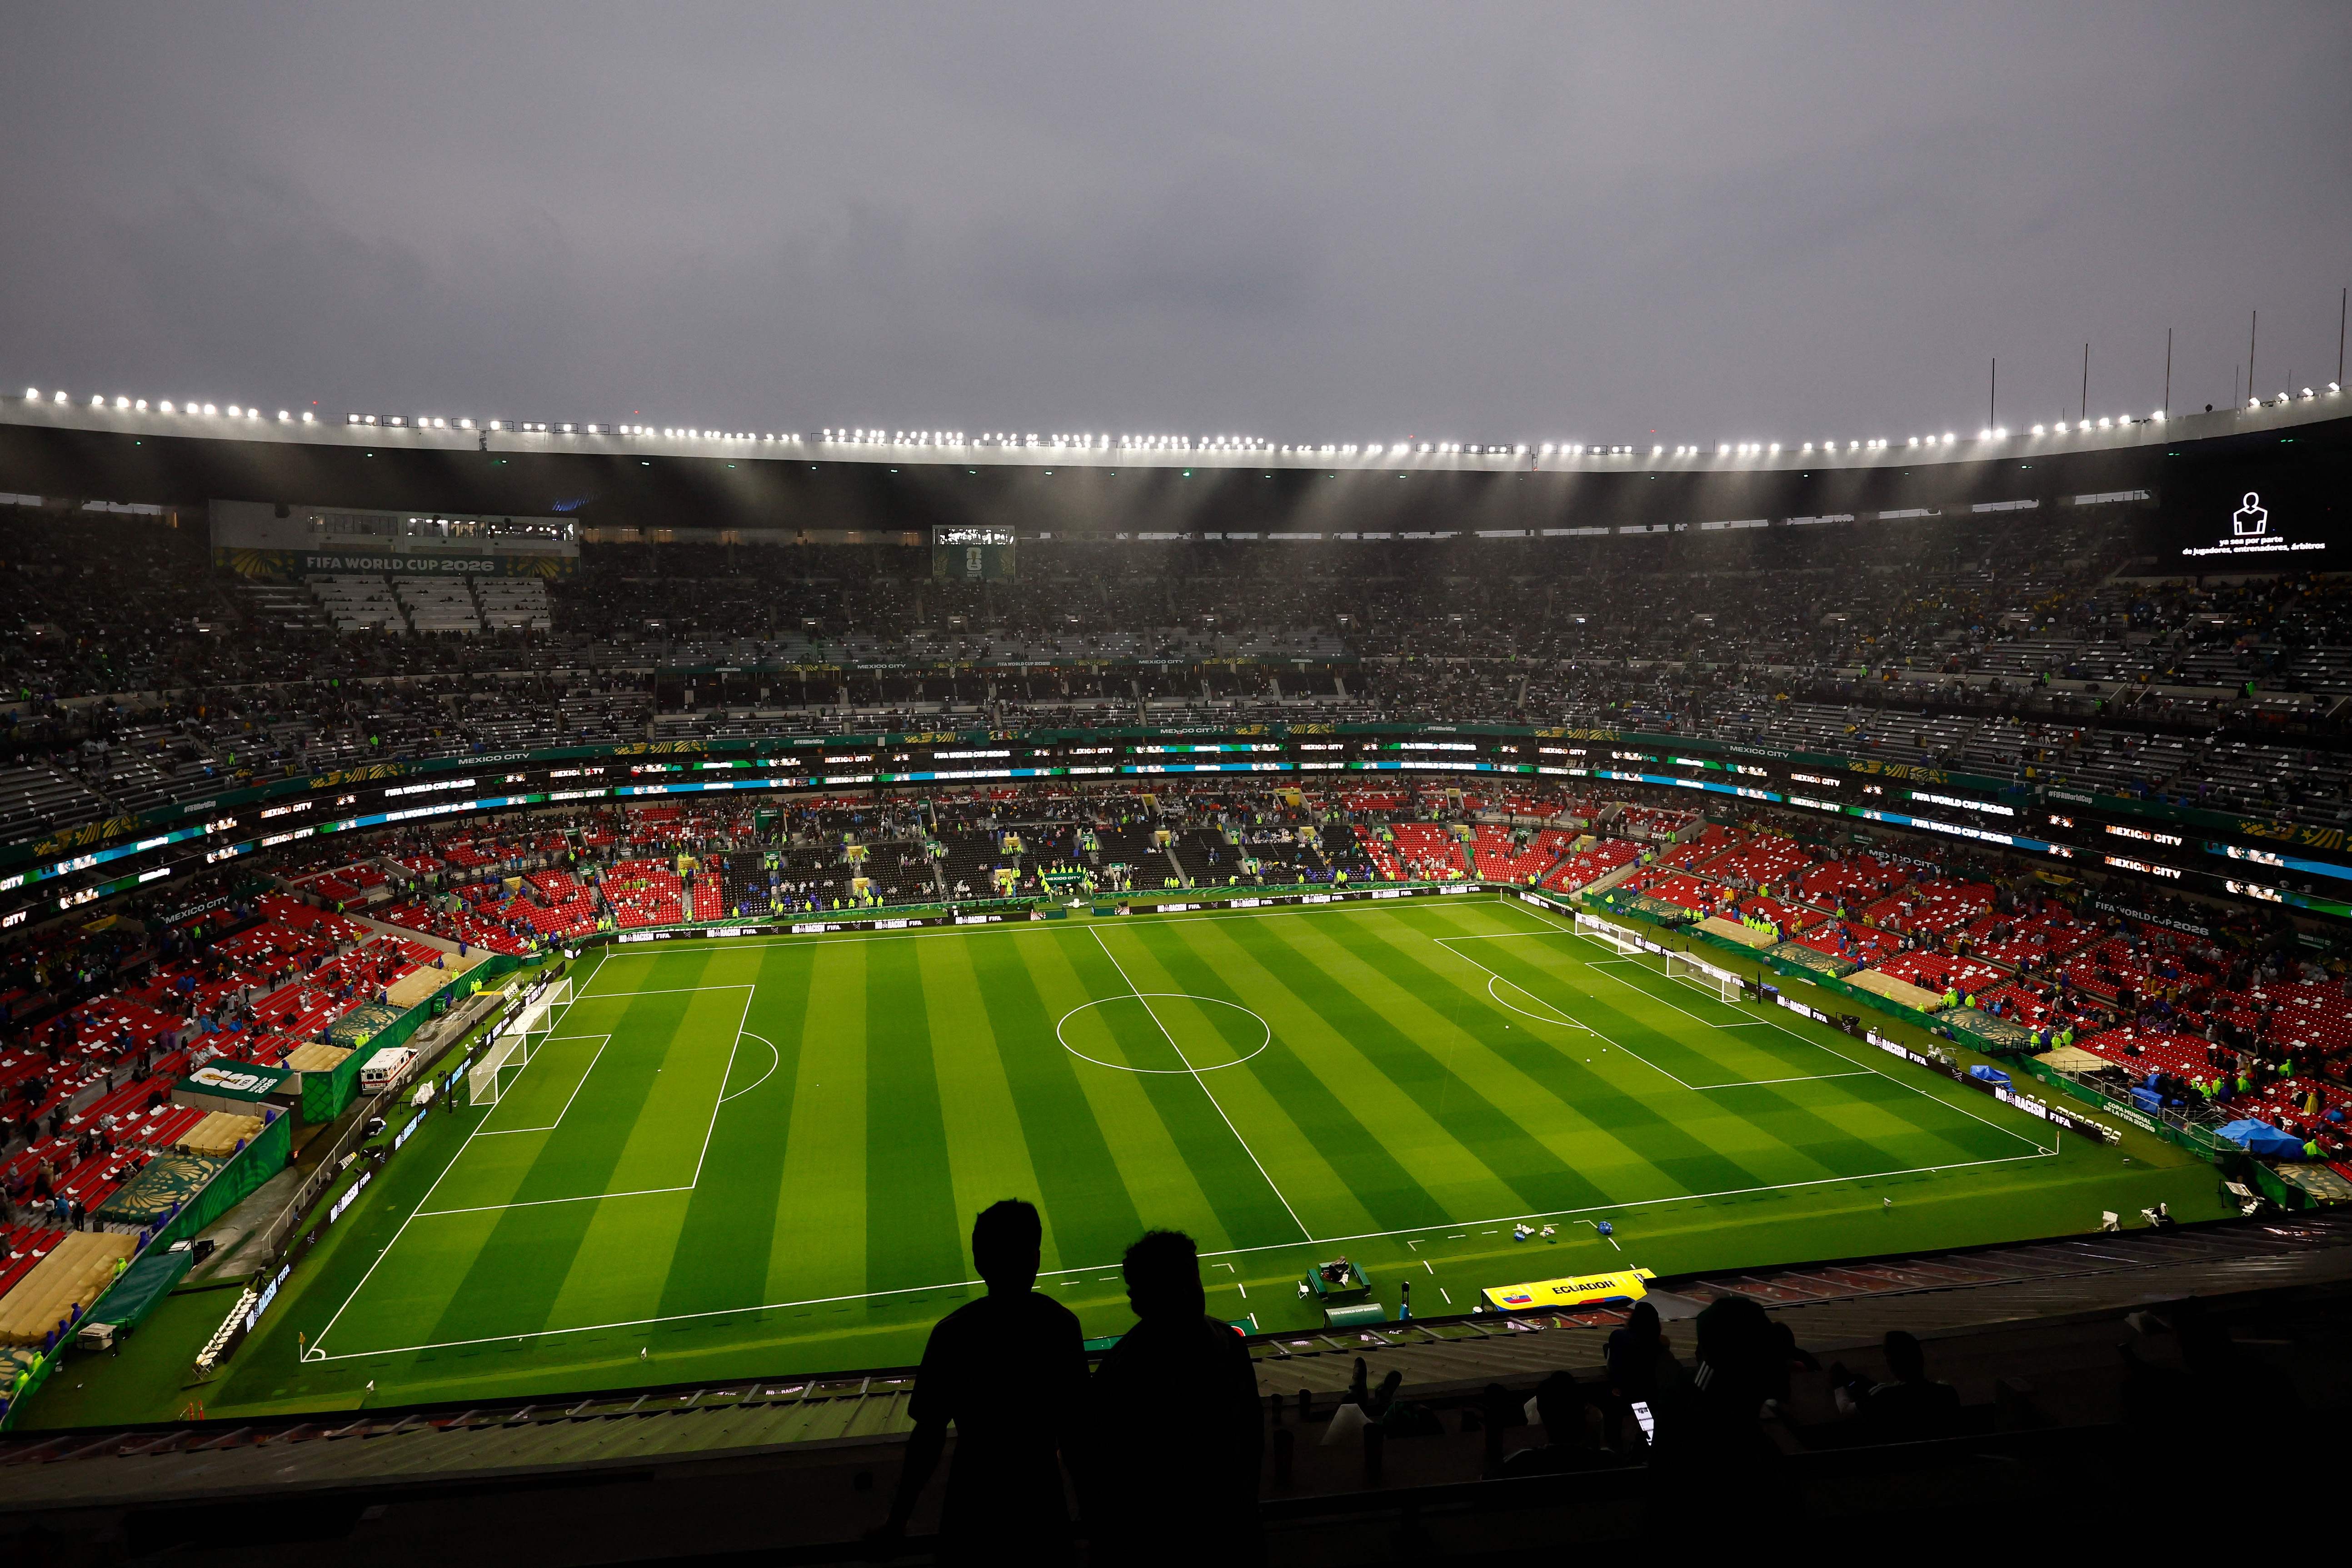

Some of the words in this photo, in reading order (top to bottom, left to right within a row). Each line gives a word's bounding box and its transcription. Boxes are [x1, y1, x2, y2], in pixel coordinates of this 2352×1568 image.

[2261, 536, 2283, 544] parte
[2193, 547, 2232, 556] jugadores,
[2233, 544, 2289, 553] entrenadores,
[307, 556, 342, 569] FIFA
[345, 558, 404, 570] WORLD
[407, 559, 439, 570] CUP
[441, 559, 495, 571] 2026
[1729, 745, 1765, 755] MEXICO
[1767, 749, 1789, 758] CITY
[458, 754, 501, 765] MEXICO
[1791, 774, 1821, 784] MEXICO
[1822, 778, 1840, 787] CITY
[385, 788, 404, 797] FIFA
[403, 784, 433, 794] WORLD
[433, 782, 450, 790] CUP
[551, 792, 585, 801] MEXICO
[1790, 797, 1820, 808] MEXICO
[1822, 804, 1840, 812] CITY
[1912, 792, 1930, 802] FIFA
[1930, 794, 1962, 807] WORLD
[1962, 800, 1981, 810] CUP
[2047, 791, 2092, 804] #FIFAWorldCup
[260, 806, 291, 819] MEXICO
[293, 802, 312, 812] CITY
[386, 811, 404, 821] FIFA
[404, 808, 434, 818] WORLD
[434, 805, 451, 814] CUP
[1911, 819, 1930, 829] FIFA
[1930, 822, 1962, 835] WORLD
[1962, 828, 1980, 838] CUP
[2106, 825, 2151, 840] MEXICO
[2153, 834, 2182, 846] CITY
[261, 833, 293, 846] MEXICO
[295, 828, 313, 839] CITY
[2104, 856, 2150, 872] MEXICO
[2152, 866, 2181, 879] CITY
[0, 875, 24, 891] CITY
[165, 903, 205, 925] MEXICO
[206, 895, 229, 909] CITY
[1157, 904, 1164, 913] NO
[1169, 904, 1187, 912] RACISM
[3, 911, 26, 928] CITY
[874, 921, 883, 929] NO
[887, 920, 907, 929] RACISM
[955, 916, 963, 924] NO
[968, 915, 987, 924] RACISM
[2095, 901, 2115, 913] FIFA
[2173, 920, 2209, 936] 2026
[720, 928, 741, 937] RACISM
[792, 925, 800, 934] NO
[805, 924, 825, 933] RACISM
[619, 934, 627, 943] NO
[632, 933, 654, 942] RACISM
[1777, 994, 1785, 1006] NO
[1790, 1000, 1811, 1018] RACISM
[1813, 1011, 1828, 1024] FIFA
[1867, 1032, 1876, 1046] NO
[1882, 1039, 1907, 1059] RACISM
[1909, 1052, 1928, 1066] FIFA
[239, 1079, 251, 1087] FIFA
[247, 1082, 262, 1092] WORLD
[255, 1078, 278, 1094] 2026
[1995, 1086, 2007, 1102] NO
[2014, 1095, 2046, 1119] RACISM
[2050, 1112, 2072, 1129] FIFA
[2107, 1102, 2124, 1113] COPA
[2124, 1109, 2151, 1125] MUNDIAL
[2119, 1112, 2133, 1124] FIFA
[2133, 1118, 2156, 1133] 2026
[1552, 1280, 1616, 1295] ECUADOR
[246, 1310, 255, 1333] NO
[258, 1278, 277, 1316] RACISM
[278, 1263, 290, 1285] FIFA
